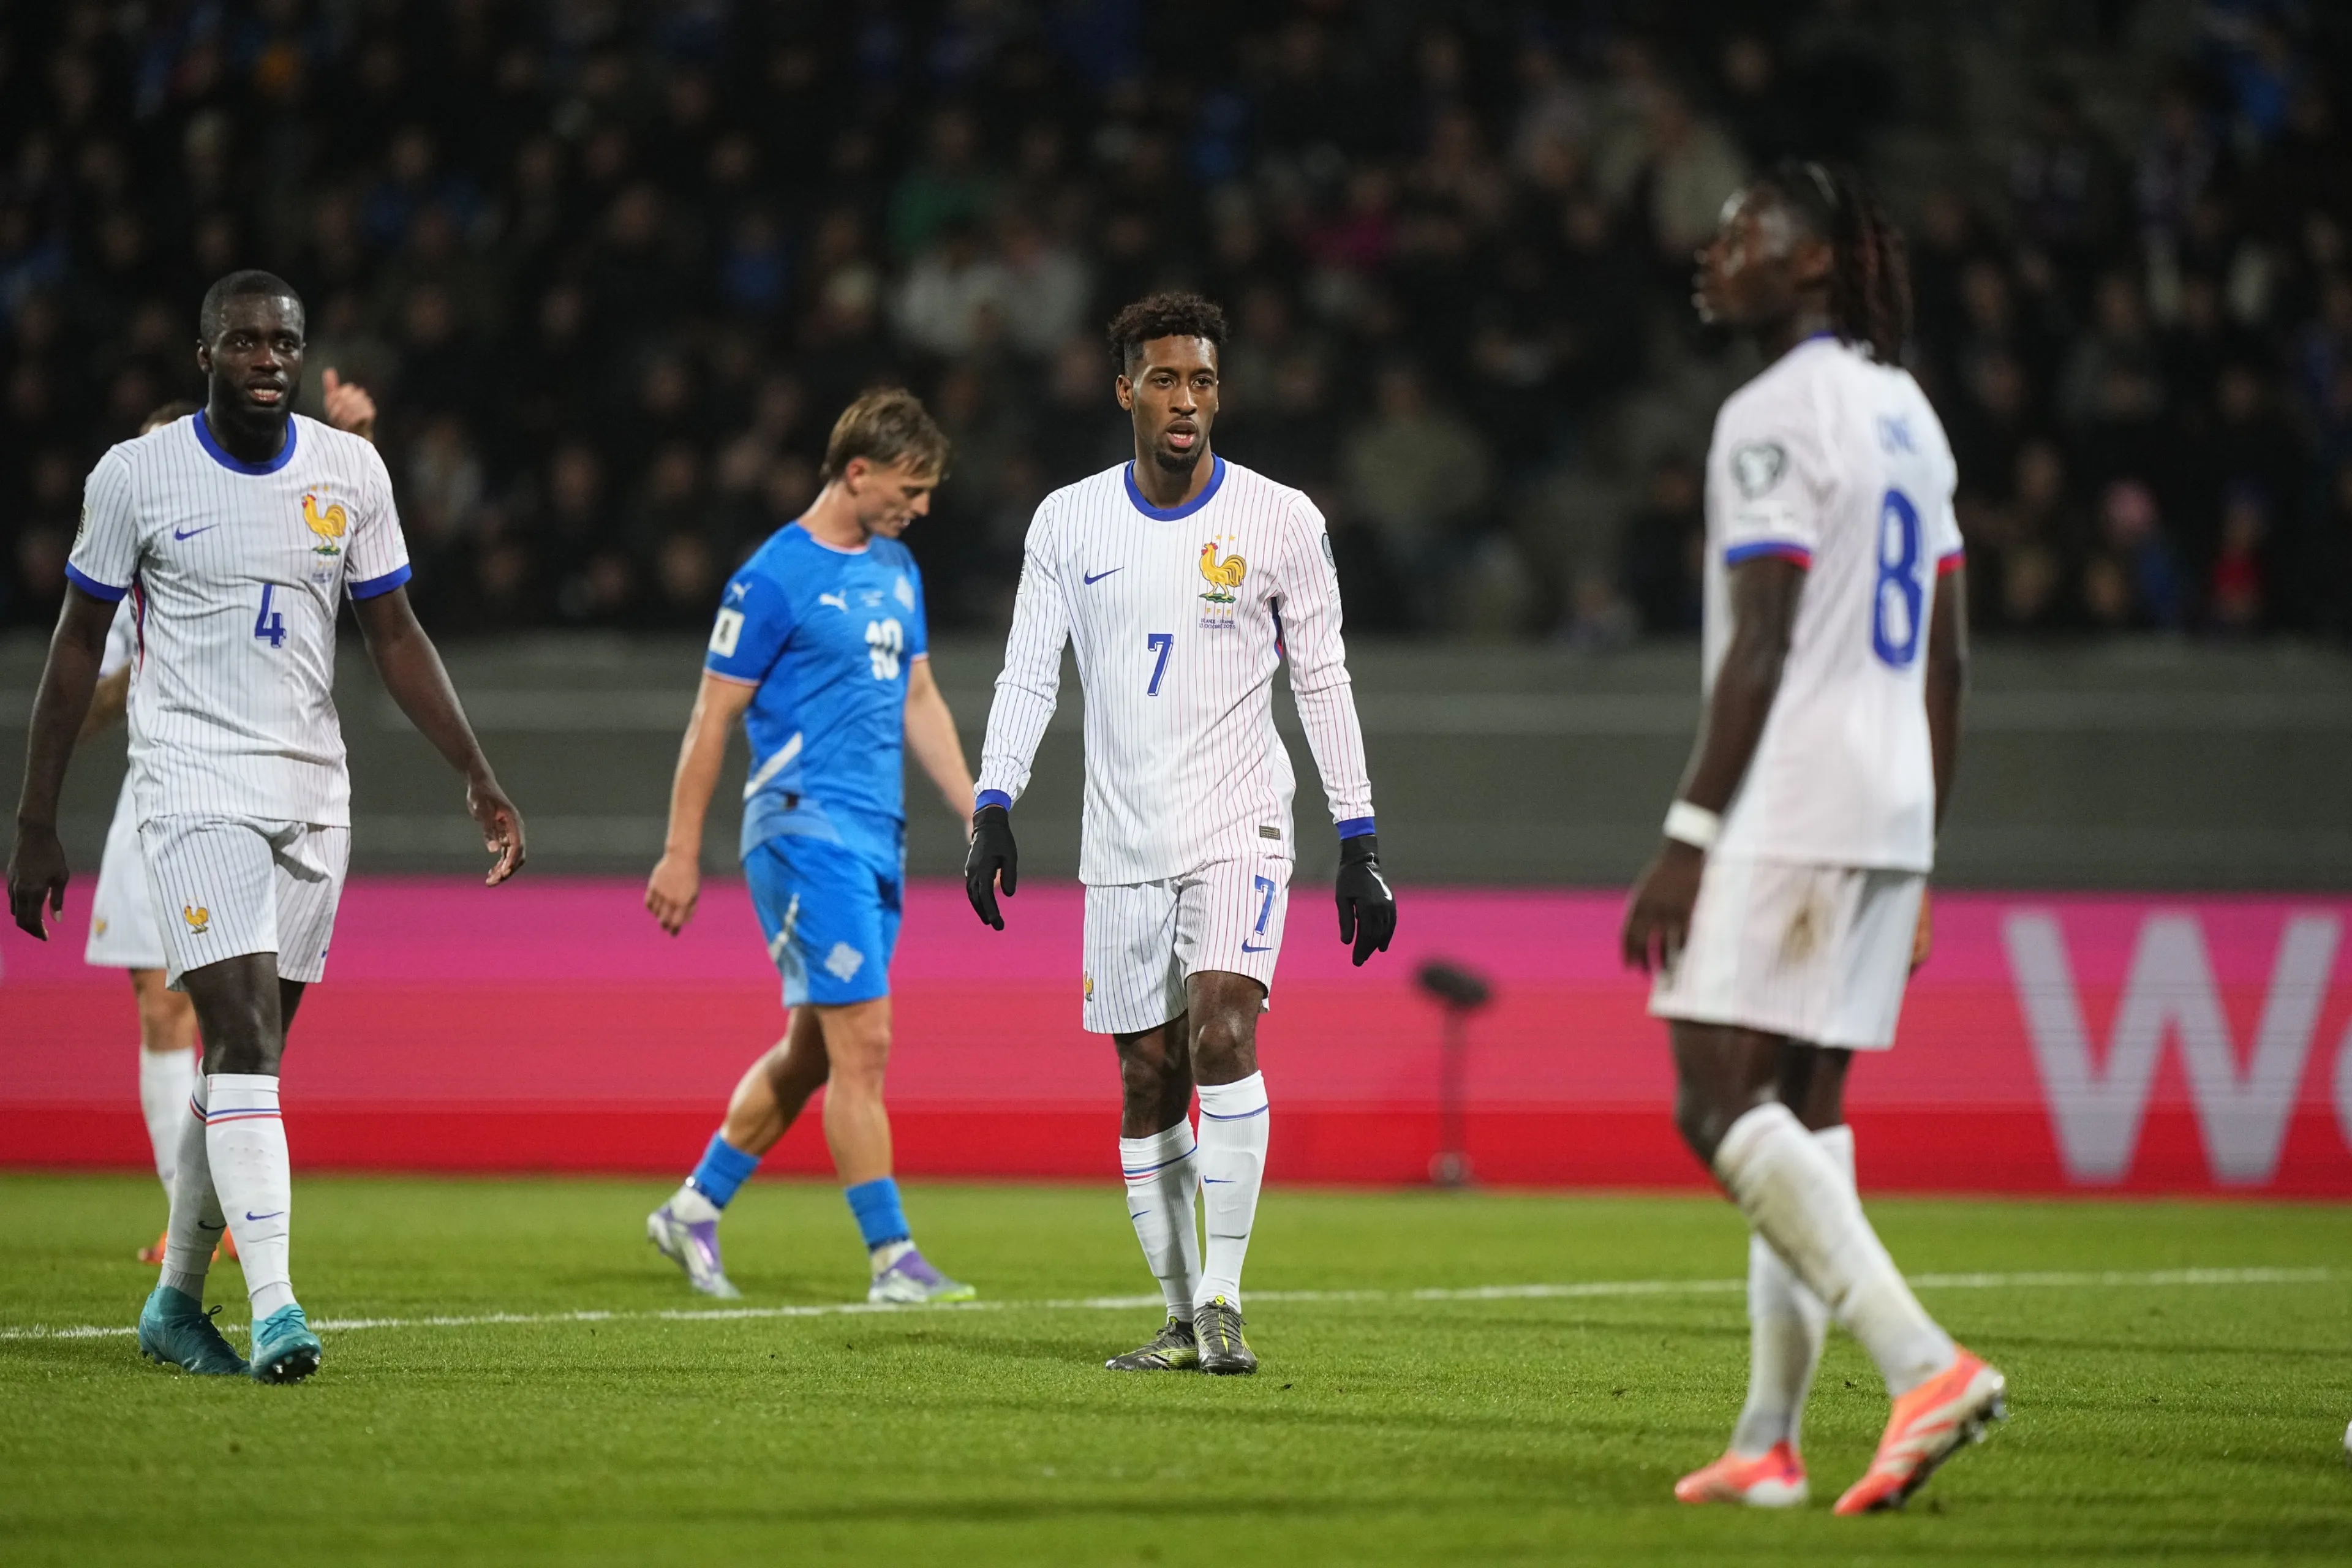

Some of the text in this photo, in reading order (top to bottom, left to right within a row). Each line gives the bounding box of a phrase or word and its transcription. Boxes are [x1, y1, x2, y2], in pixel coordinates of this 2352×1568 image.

[1873, 488, 1923, 668] 8
[254, 582, 287, 648] 4
[864, 617, 903, 680] 10
[1147, 633, 1174, 696] 7
[1254, 875, 1275, 935] 7
[2002, 910, 2352, 1186] W
